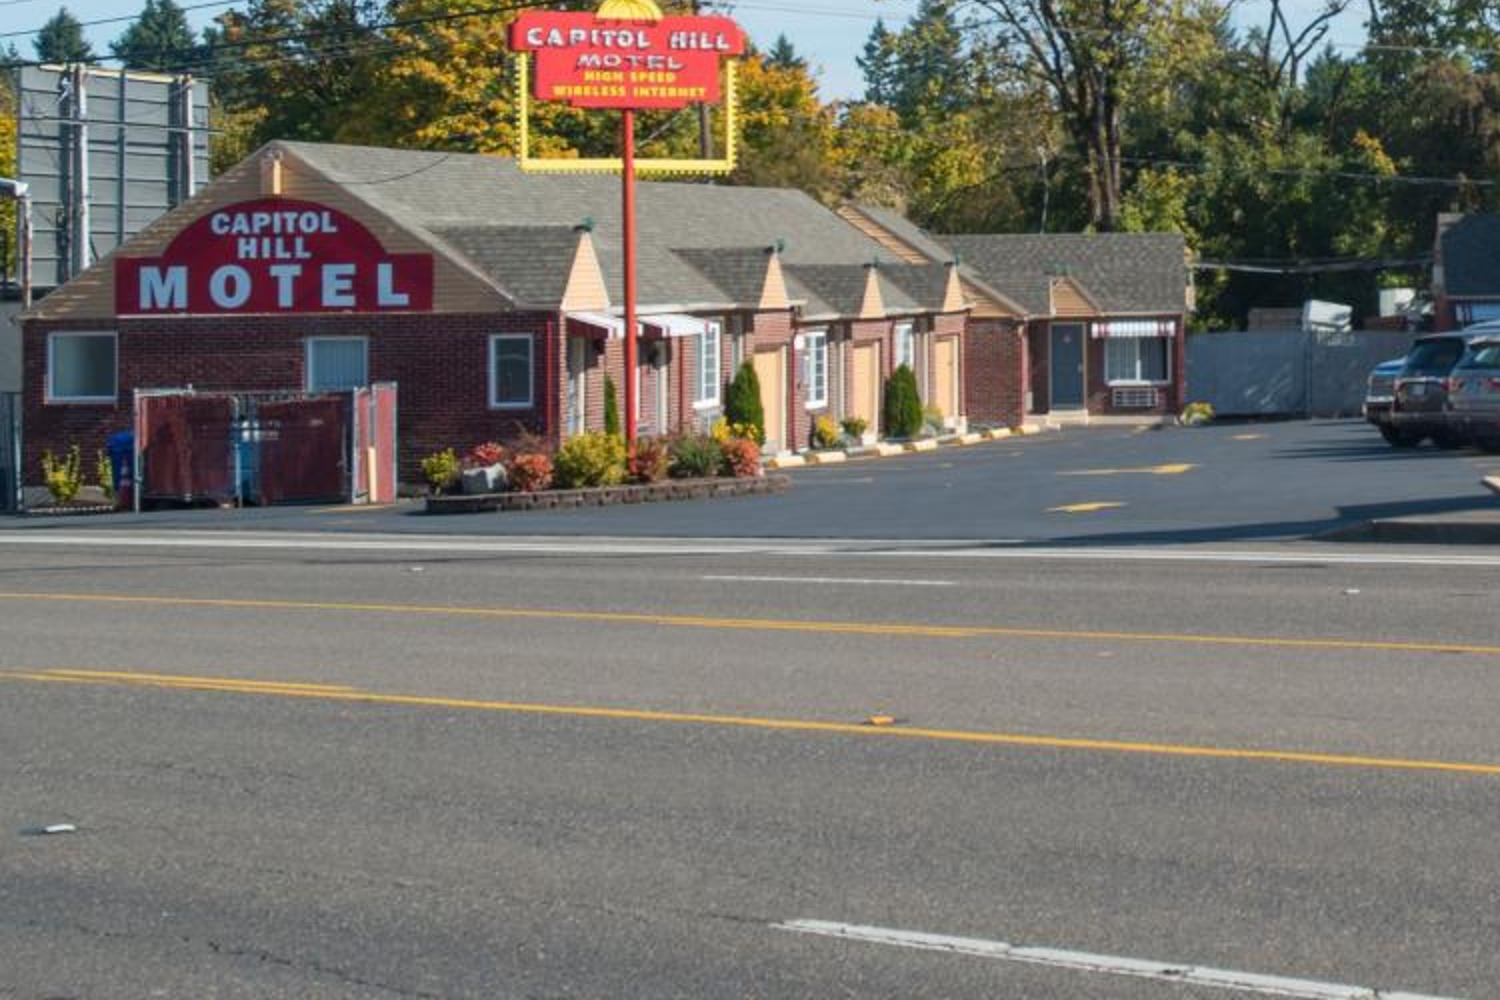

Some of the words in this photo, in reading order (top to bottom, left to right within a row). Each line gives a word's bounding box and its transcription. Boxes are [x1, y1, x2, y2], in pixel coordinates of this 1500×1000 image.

[526, 26, 651, 49] CAPITOL
[669, 31, 731, 50] HILL
[576, 53, 684, 71] MOTEL
[584, 71, 624, 83] HIGH
[630, 71, 677, 83] SPEED
[553, 85, 627, 97] WIRELESS
[633, 86, 706, 97] INTERNET
[211, 212, 338, 235] CAPITOL
[237, 237, 312, 259] HILL
[138, 263, 410, 309] MOTEL
